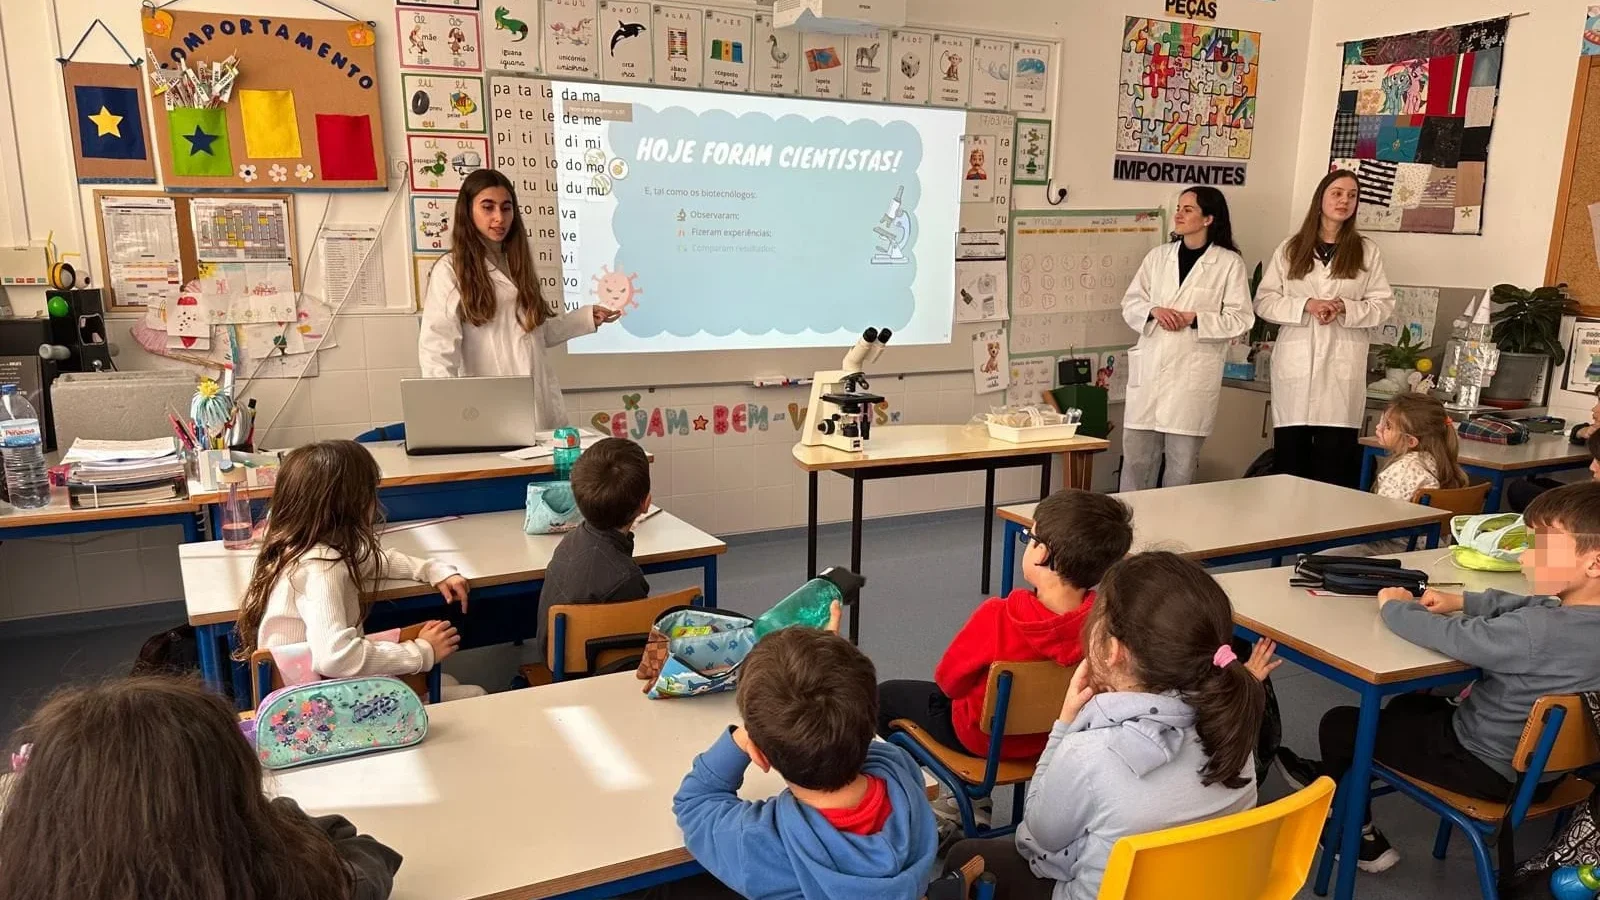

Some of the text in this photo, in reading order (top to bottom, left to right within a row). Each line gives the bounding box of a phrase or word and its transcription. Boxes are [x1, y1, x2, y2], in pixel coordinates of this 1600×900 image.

[1164, 0, 1217, 19] PEÇAS
[421, 33, 437, 41] mãe
[160, 18, 373, 89] OMPORTAMENTO
[462, 44, 475, 52] cão
[501, 49, 522, 57] iguana
[500, 59, 526, 69] iguana
[493, 84, 600, 102] pa ta la da ma
[495, 108, 512, 120] pe
[519, 109, 533, 120] te
[542, 108, 555, 121] le
[562, 111, 579, 124] de
[583, 115, 602, 126] me
[498, 129, 601, 148] pi ti li di mi
[1000, 138, 1010, 147] ra
[636, 136, 903, 173] HOJE FORAM CIENTISTAS!
[498, 156, 604, 173] po to lo do mo
[998, 157, 1008, 166] re
[1113, 159, 1245, 186] IMPORTANTES
[999, 174, 1007, 185] ri
[523, 179, 537, 191] tu
[546, 179, 558, 192] lu
[566, 181, 582, 193] du
[587, 187, 605, 196] mu
[654, 187, 664, 196] tal
[666, 189, 689, 197] como
[690, 189, 700, 197] os
[996, 196, 1006, 205] ro
[538, 205, 555, 215] na
[561, 209, 577, 219] va
[690, 210, 740, 220] Observaram;
[997, 215, 1007, 224] ru
[539, 228, 555, 238] ne
[561, 232, 577, 242] ve
[691, 228, 772, 239] Fizeram experiências;
[432, 239, 442, 249] oi
[539, 248, 574, 264] ni vi
[540, 276, 578, 287] no vo
[564, 301, 579, 311] vu
[591, 407, 690, 440] SEJAM
